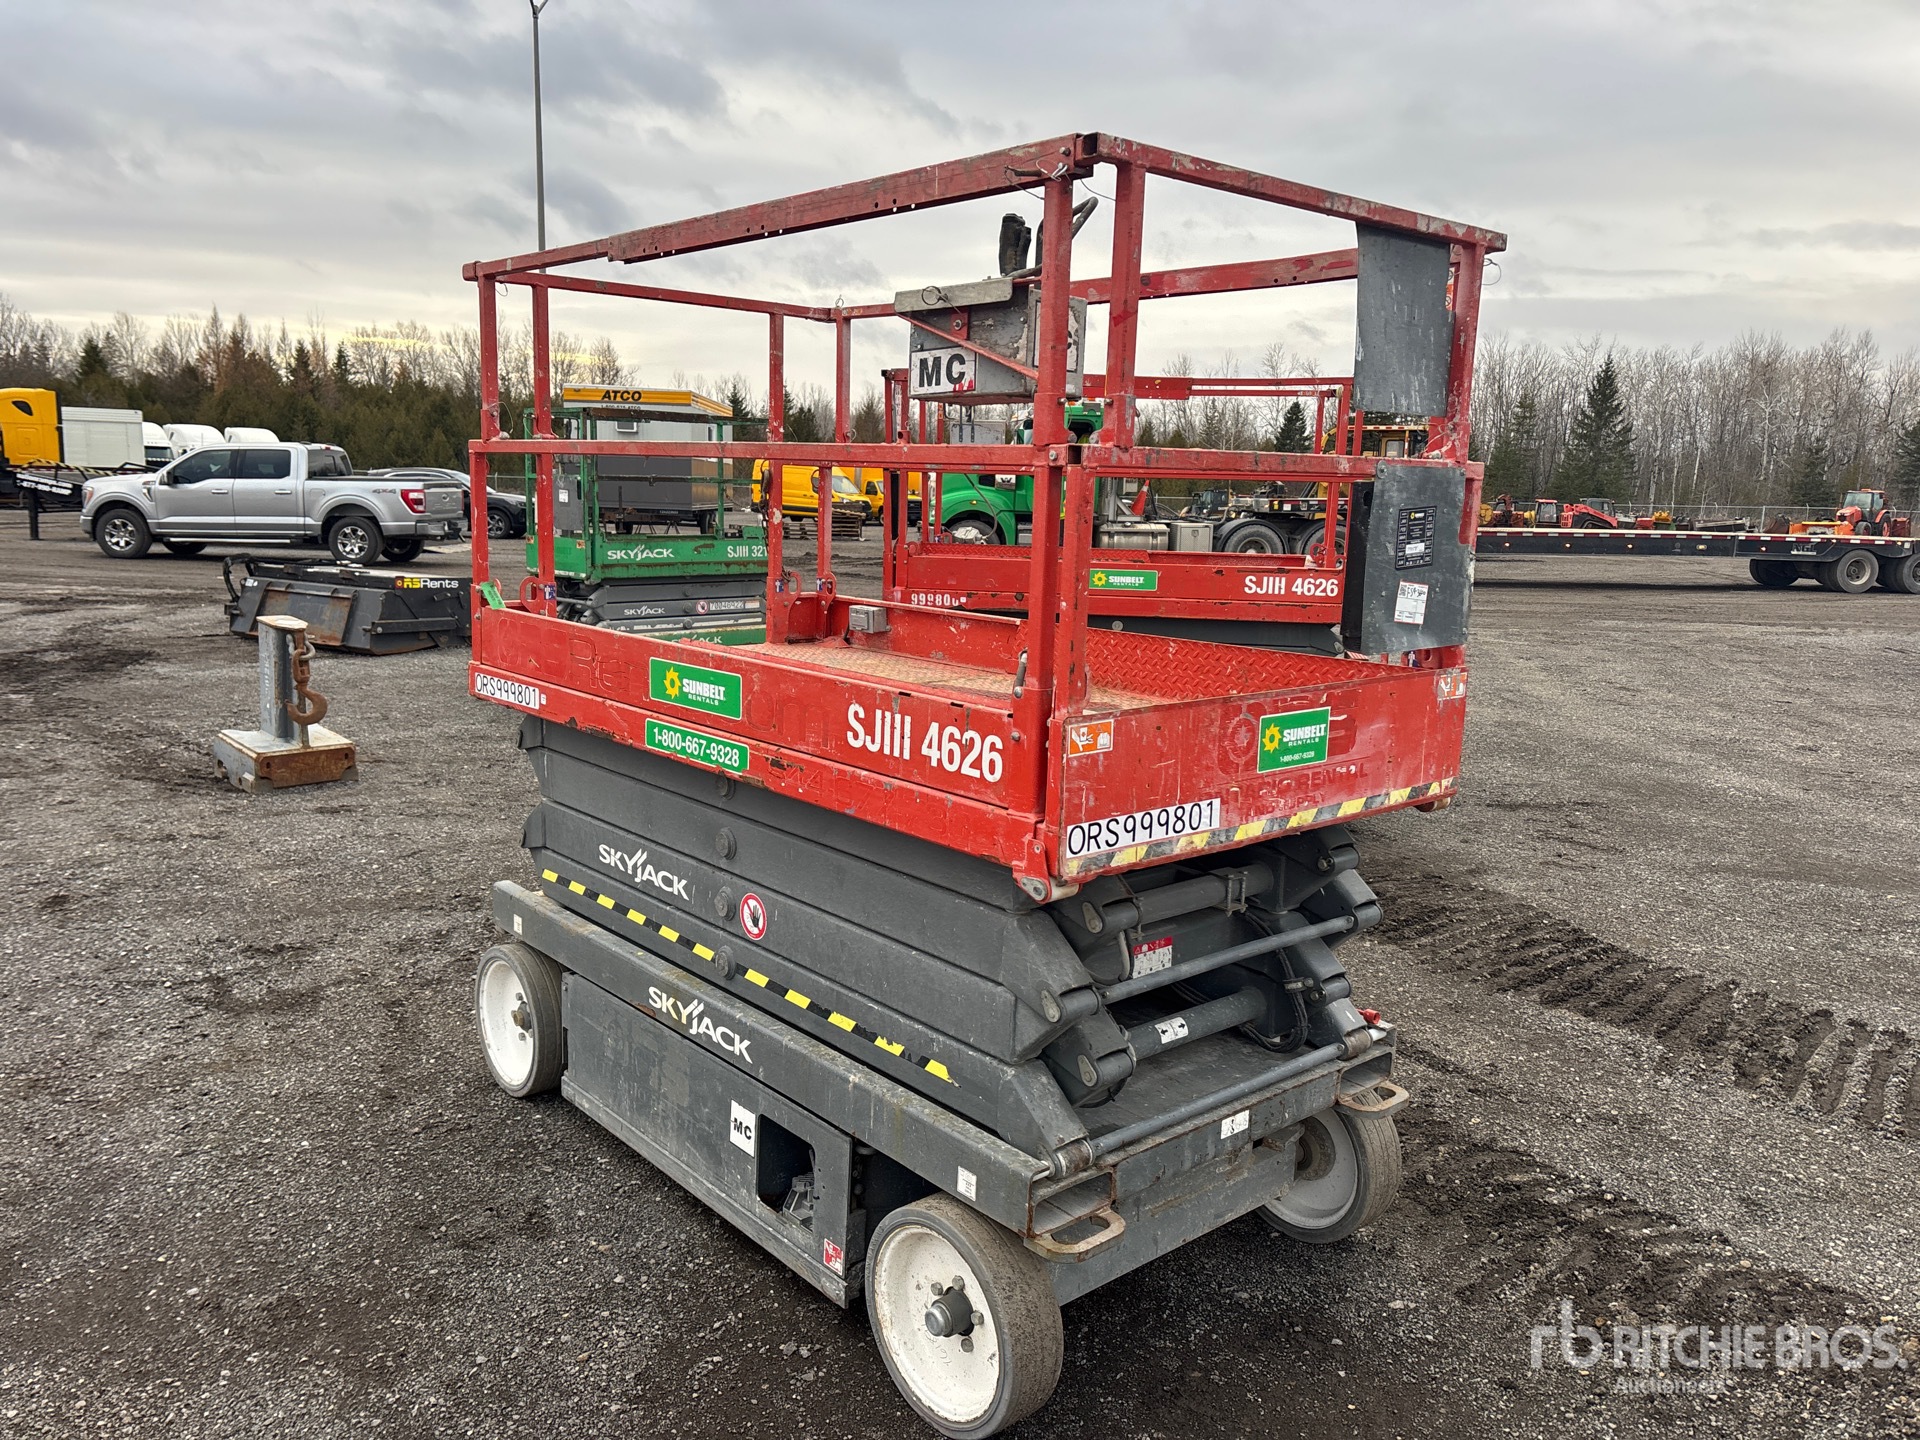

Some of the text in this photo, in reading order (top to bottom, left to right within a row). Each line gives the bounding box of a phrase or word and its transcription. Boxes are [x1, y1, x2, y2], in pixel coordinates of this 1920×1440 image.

[919, 353, 966, 388] MC
[601, 389, 642, 402] ATCO
[607, 544, 675, 561] SKYJACK
[751, 545, 769, 558] 321
[1108, 575, 1145, 584] SUNBELT
[1291, 577, 1339, 597] 4626
[623, 605, 666, 616] SKYJACK
[475, 673, 537, 708] ORS999801
[682, 678, 726, 701] SUNBELT
[688, 693, 719, 706] RENTALS
[847, 703, 1004, 783] SJIII 4626
[1283, 723, 1327, 742] SUNBELT
[1288, 737, 1319, 747] RENTALS
[653, 726, 740, 768] 1-800-667-9328
[1068, 801, 1214, 856] ORS999801
[598, 843, 690, 901] SKYJACK
[648, 986, 753, 1065] SKYJACK
[733, 1116, 752, 1141] MC
